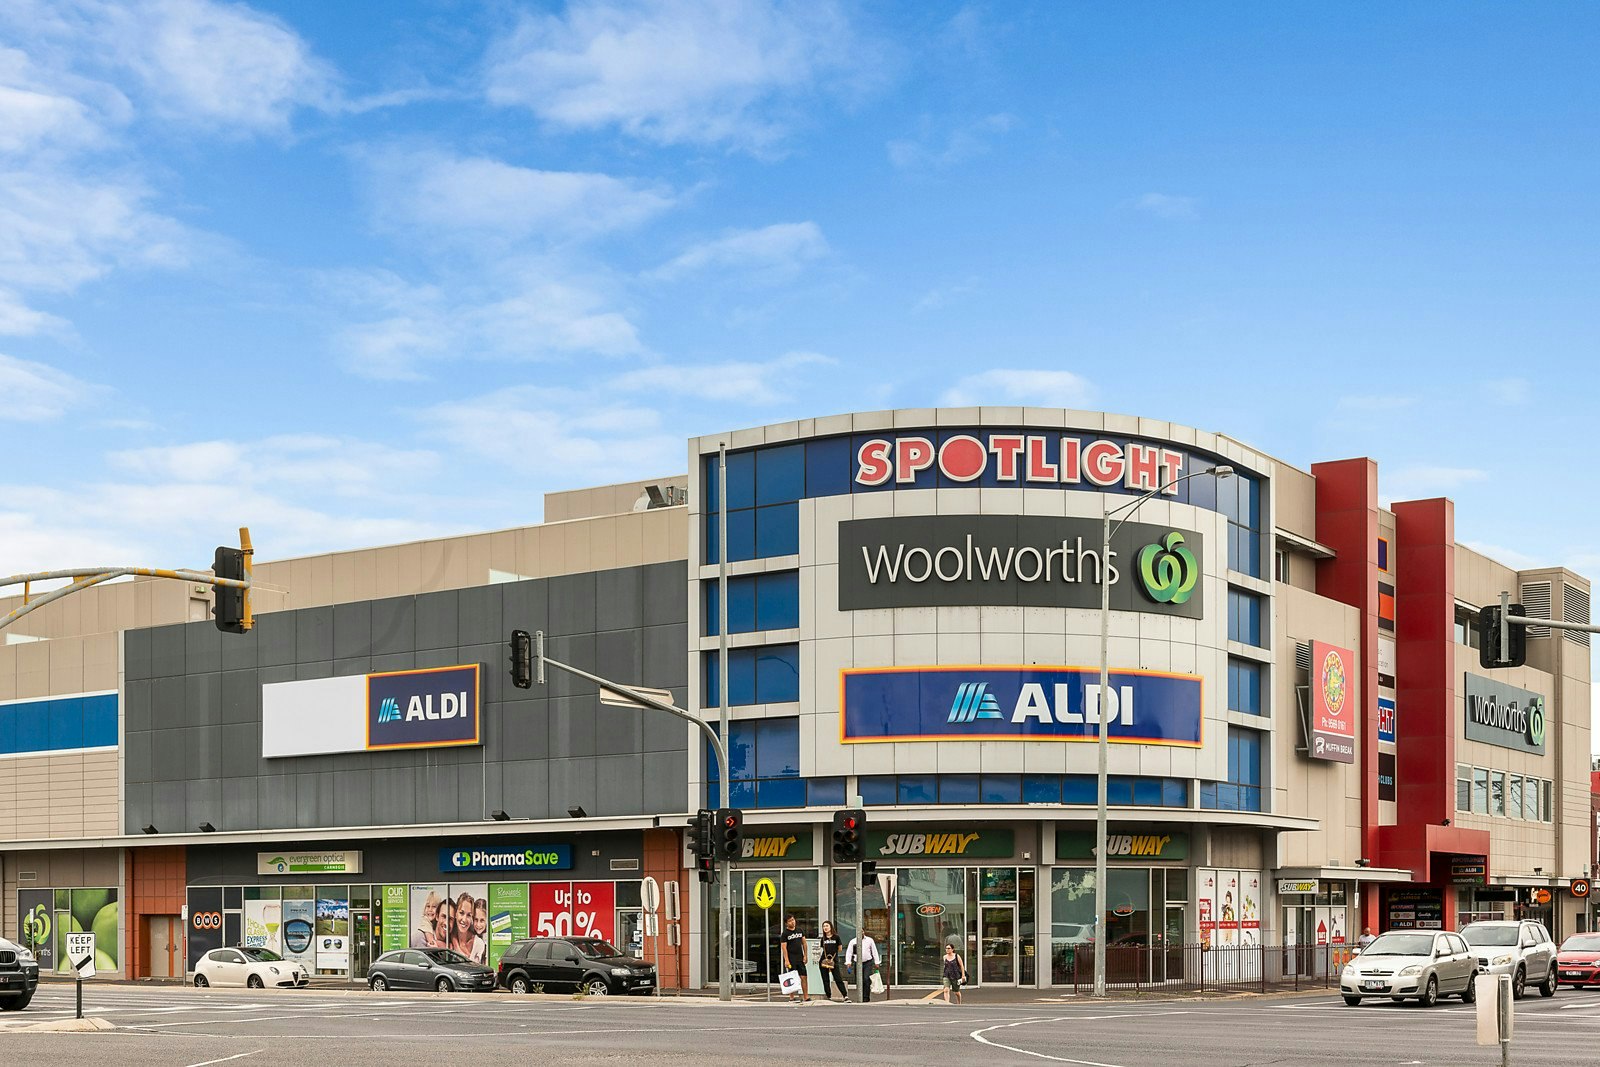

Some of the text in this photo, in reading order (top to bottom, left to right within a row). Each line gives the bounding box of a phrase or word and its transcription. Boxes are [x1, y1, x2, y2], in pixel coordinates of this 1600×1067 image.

[855, 433, 1183, 496] SPOTLIGHT
[862, 533, 1120, 584] Woolworths
[405, 691, 467, 722] ALDI
[1010, 682, 1134, 725] ALDI
[1474, 694, 1527, 735] Woolworths
[1326, 742, 1353, 755] MUFFIN BREAK
[741, 836, 796, 858] BWAY
[880, 832, 979, 856] SUBWAY
[289, 852, 346, 865] evergreen optical
[472, 849, 559, 867] PharmaSave
[387, 887, 403, 896] OUR
[1281, 882, 1316, 893] SUBWAY
[1575, 884, 1586, 892] 40
[554, 889, 592, 908] Up to
[920, 906, 941, 914] OPEN
[194, 914, 220, 926] BWS
[536, 911, 603, 940] 50%
[70, 937, 92, 945] KEEP
[70, 946, 91, 954] LEFT
